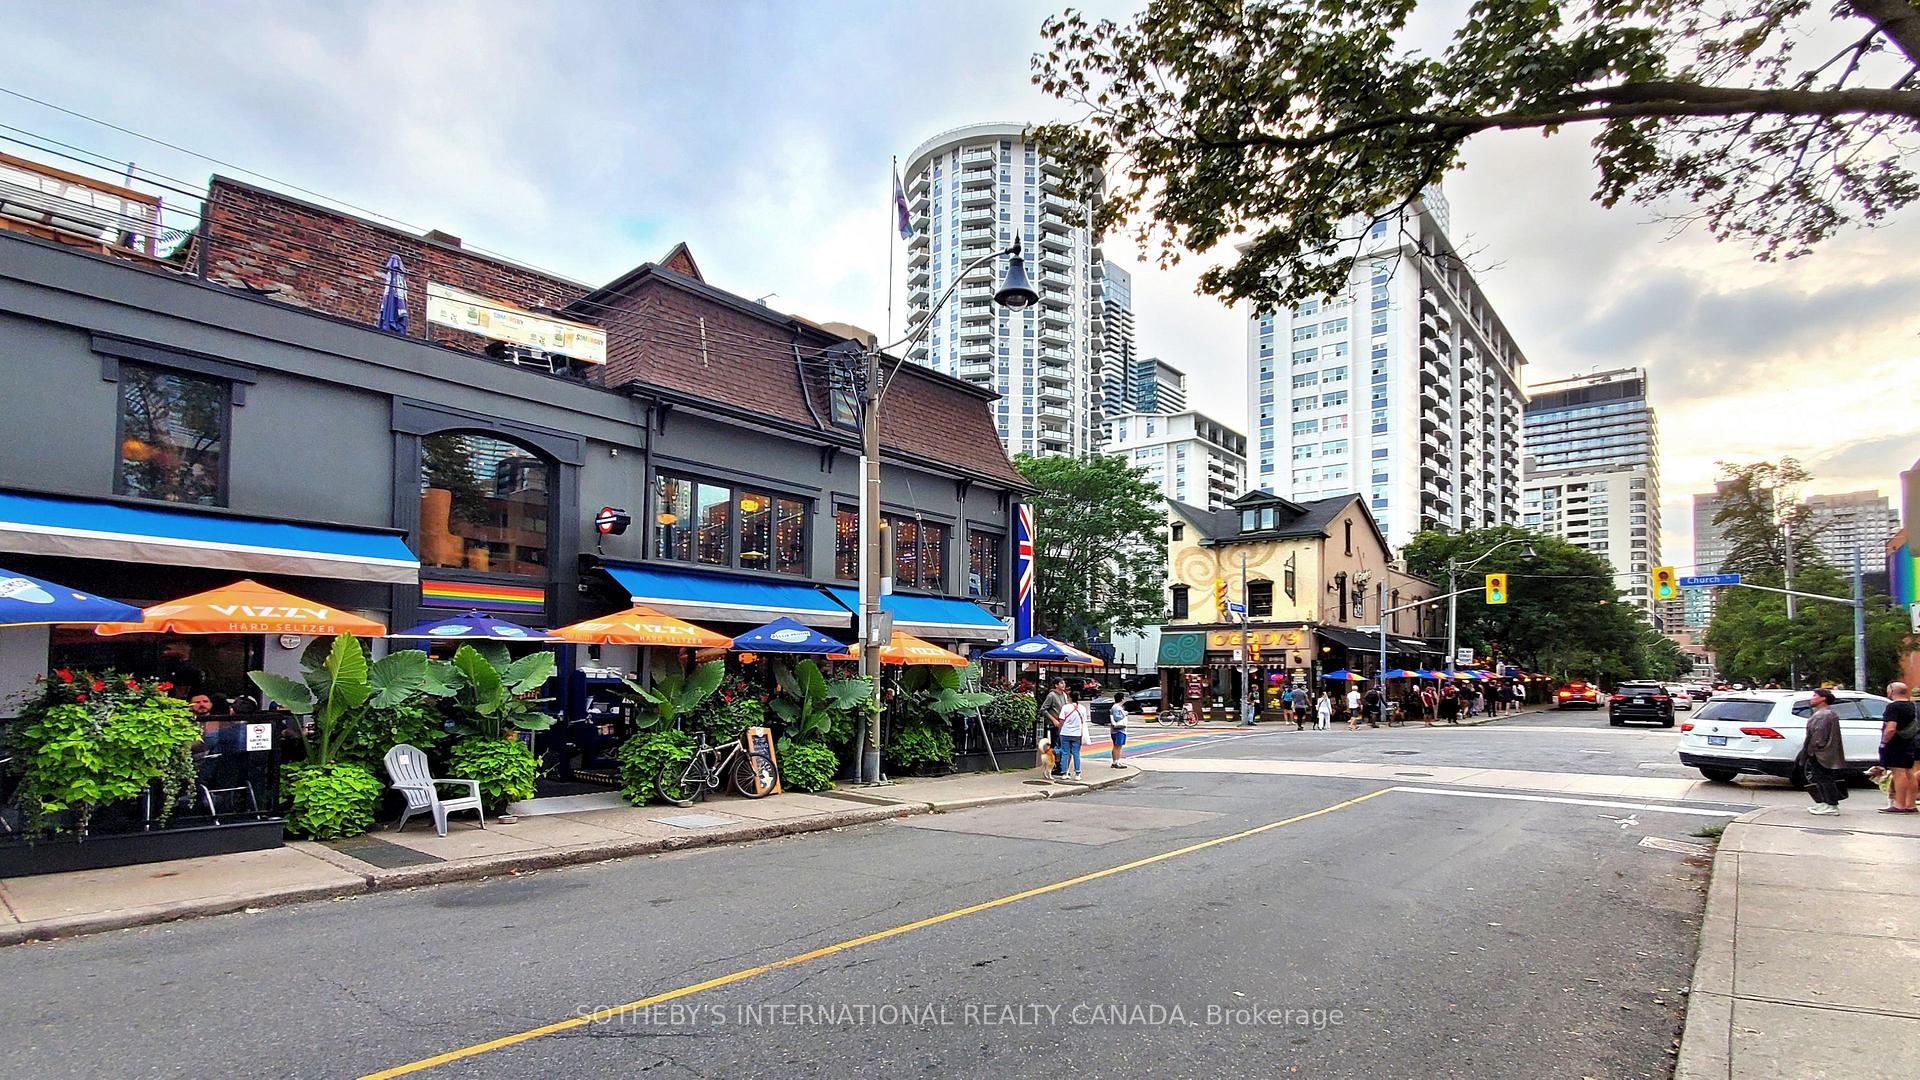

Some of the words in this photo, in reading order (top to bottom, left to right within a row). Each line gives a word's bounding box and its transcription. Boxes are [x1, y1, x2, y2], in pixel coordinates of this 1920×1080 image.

[1687, 576, 1720, 584] Church
[208, 604, 328, 619] VIZZY
[229, 622, 268, 632] HARD
[276, 624, 335, 633] SELTZER
[1213, 630, 1298, 646] O'GADY'S
